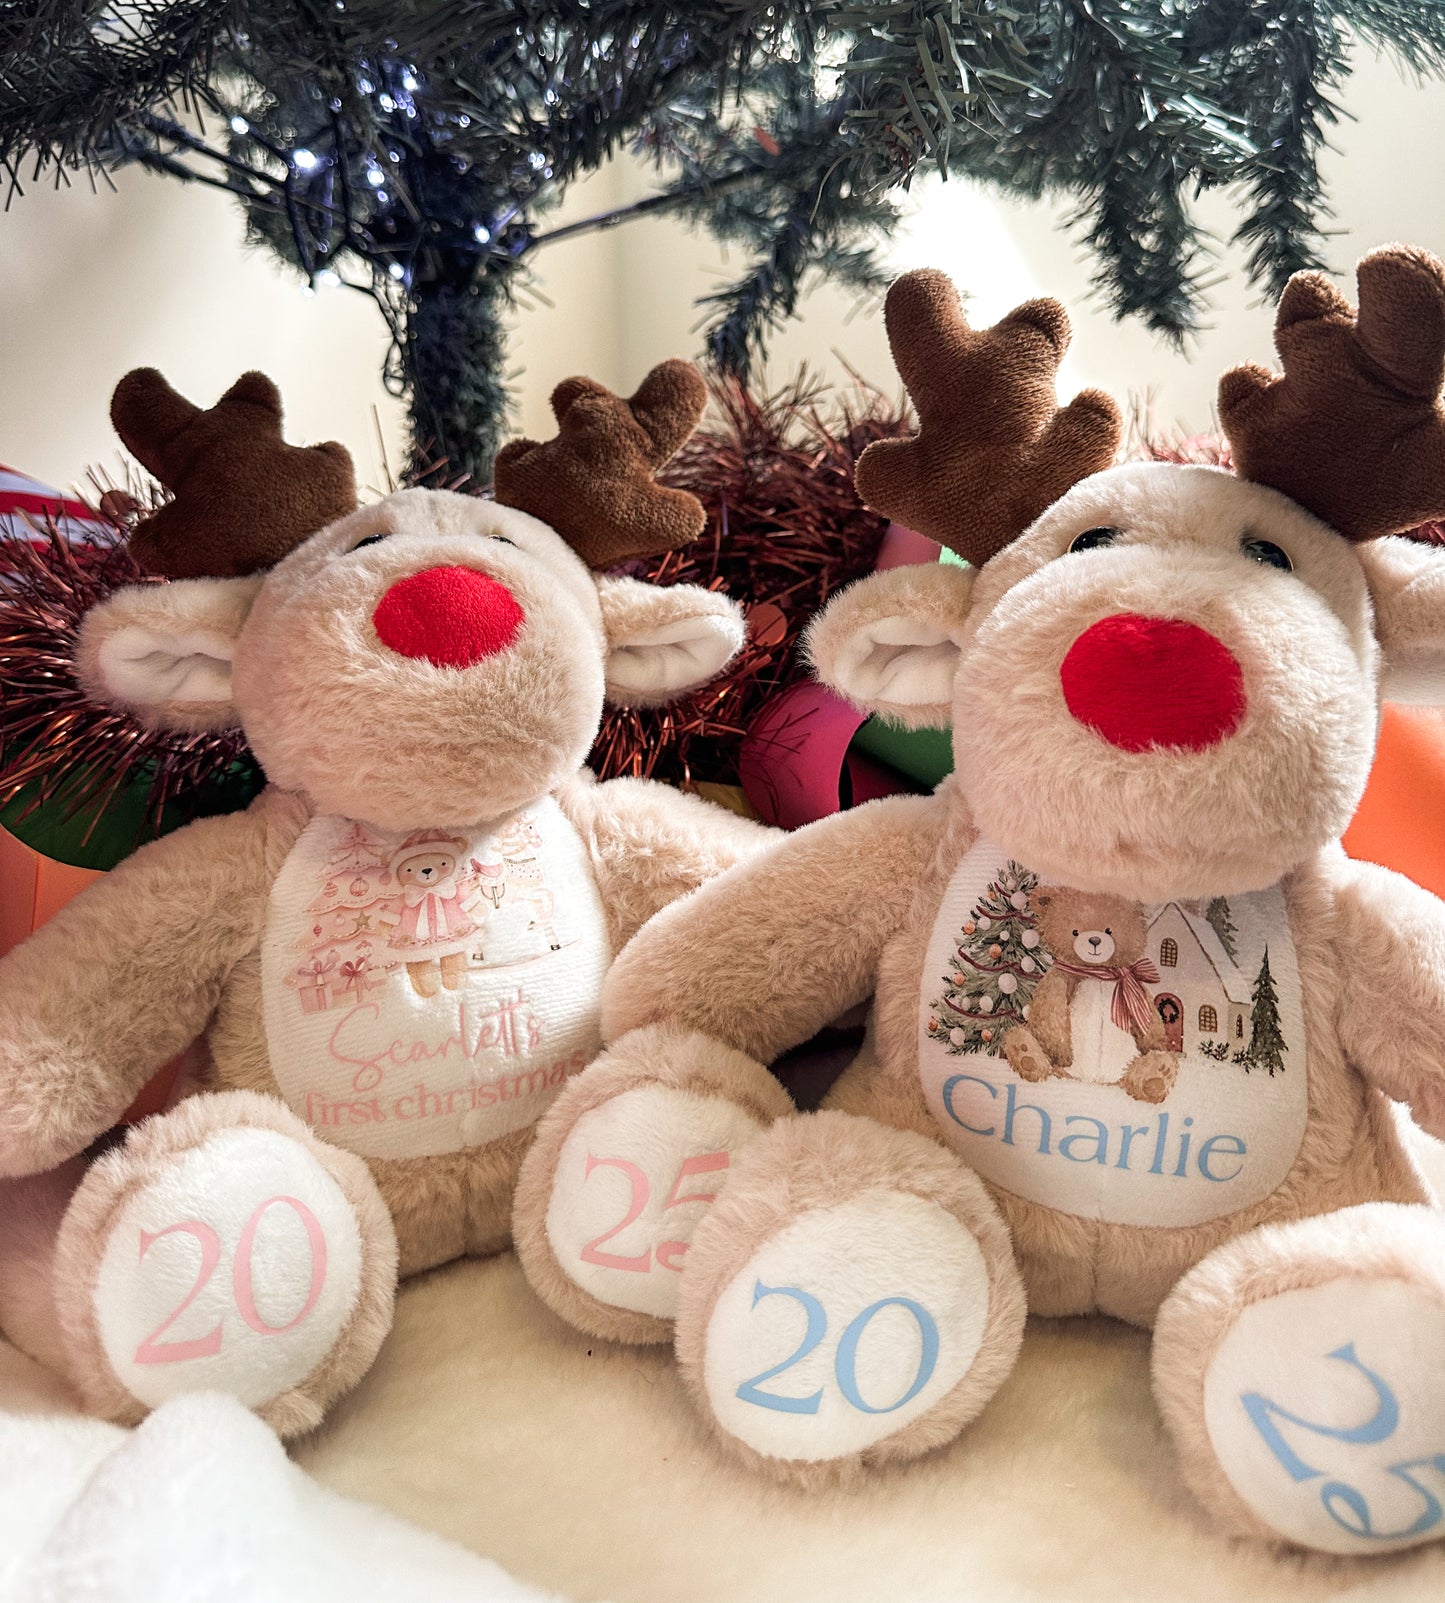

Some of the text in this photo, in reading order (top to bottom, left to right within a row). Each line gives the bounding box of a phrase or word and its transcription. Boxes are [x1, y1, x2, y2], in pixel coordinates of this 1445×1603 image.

[305, 1048, 586, 1127] first christmas
[941, 1074, 1247, 1183] Charlie
[579, 1151, 730, 1274] 25
[132, 1195, 328, 1366] 20
[735, 1278, 940, 1415] 20
[1240, 1341, 1445, 1540] 25
